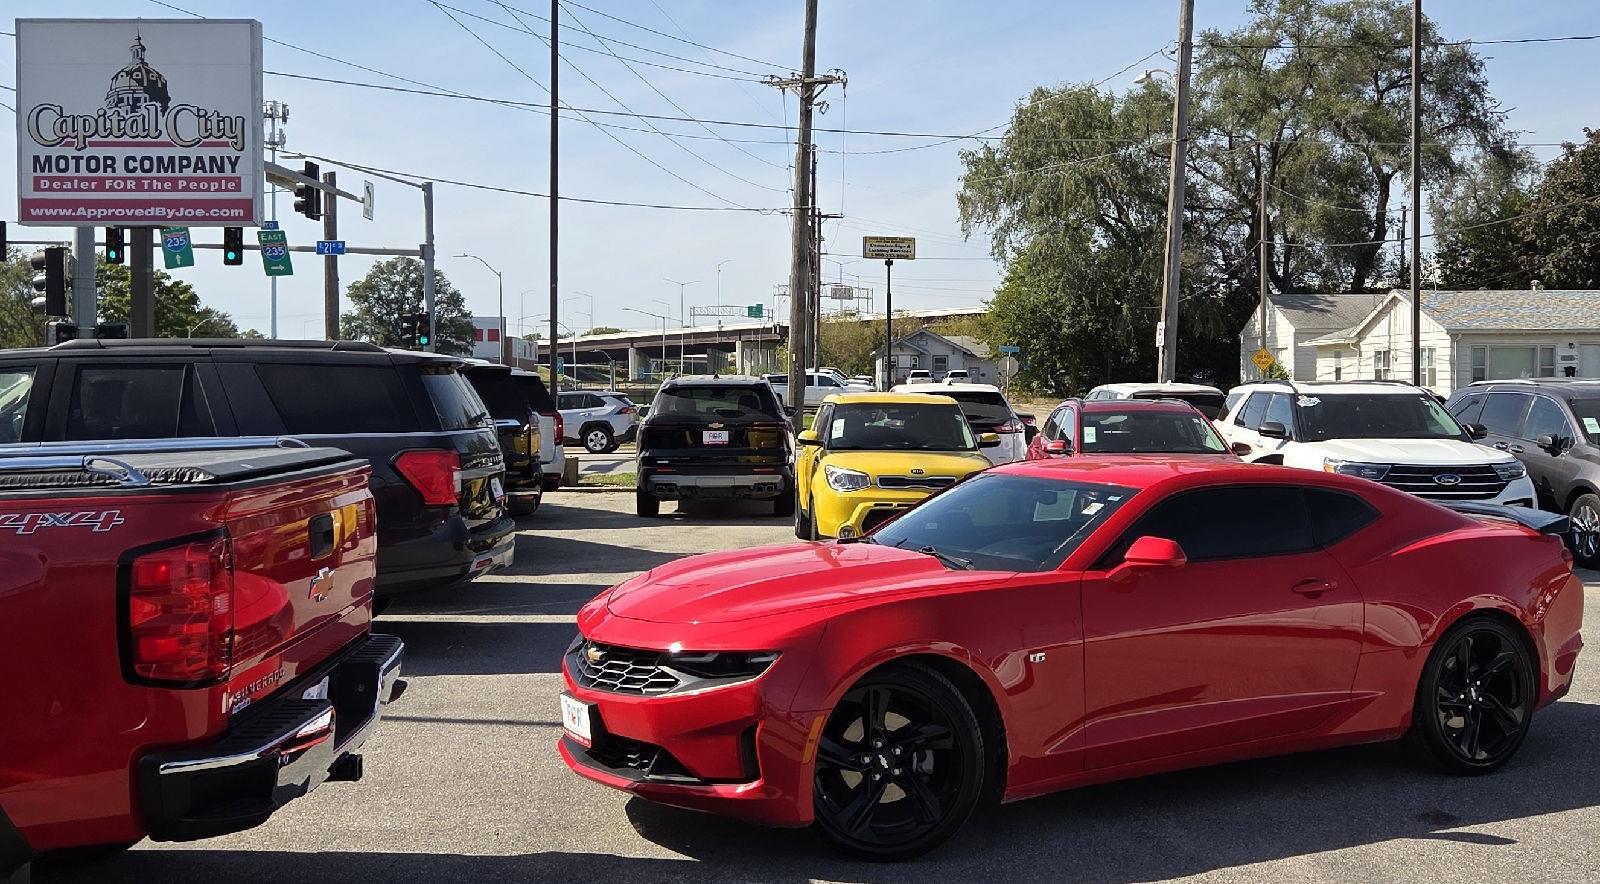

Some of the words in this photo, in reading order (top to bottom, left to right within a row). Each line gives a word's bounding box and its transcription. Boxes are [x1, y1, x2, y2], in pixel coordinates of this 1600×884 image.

[28, 103, 162, 151] Capital
[166, 104, 245, 151] City
[32, 155, 117, 174] MOTOR
[124, 155, 240, 174] COMPANY
[40, 179, 97, 190] Dealer
[105, 179, 136, 190] FOR
[142, 179, 172, 190] The
[178, 180, 236, 192] People
[30, 206, 244, 219] www.ApprovedByJoe.com
[167, 236, 186, 248] 235
[261, 233, 282, 241] EAST
[265, 246, 284, 256] 235
[234, 669, 286, 702] SILVERADO
